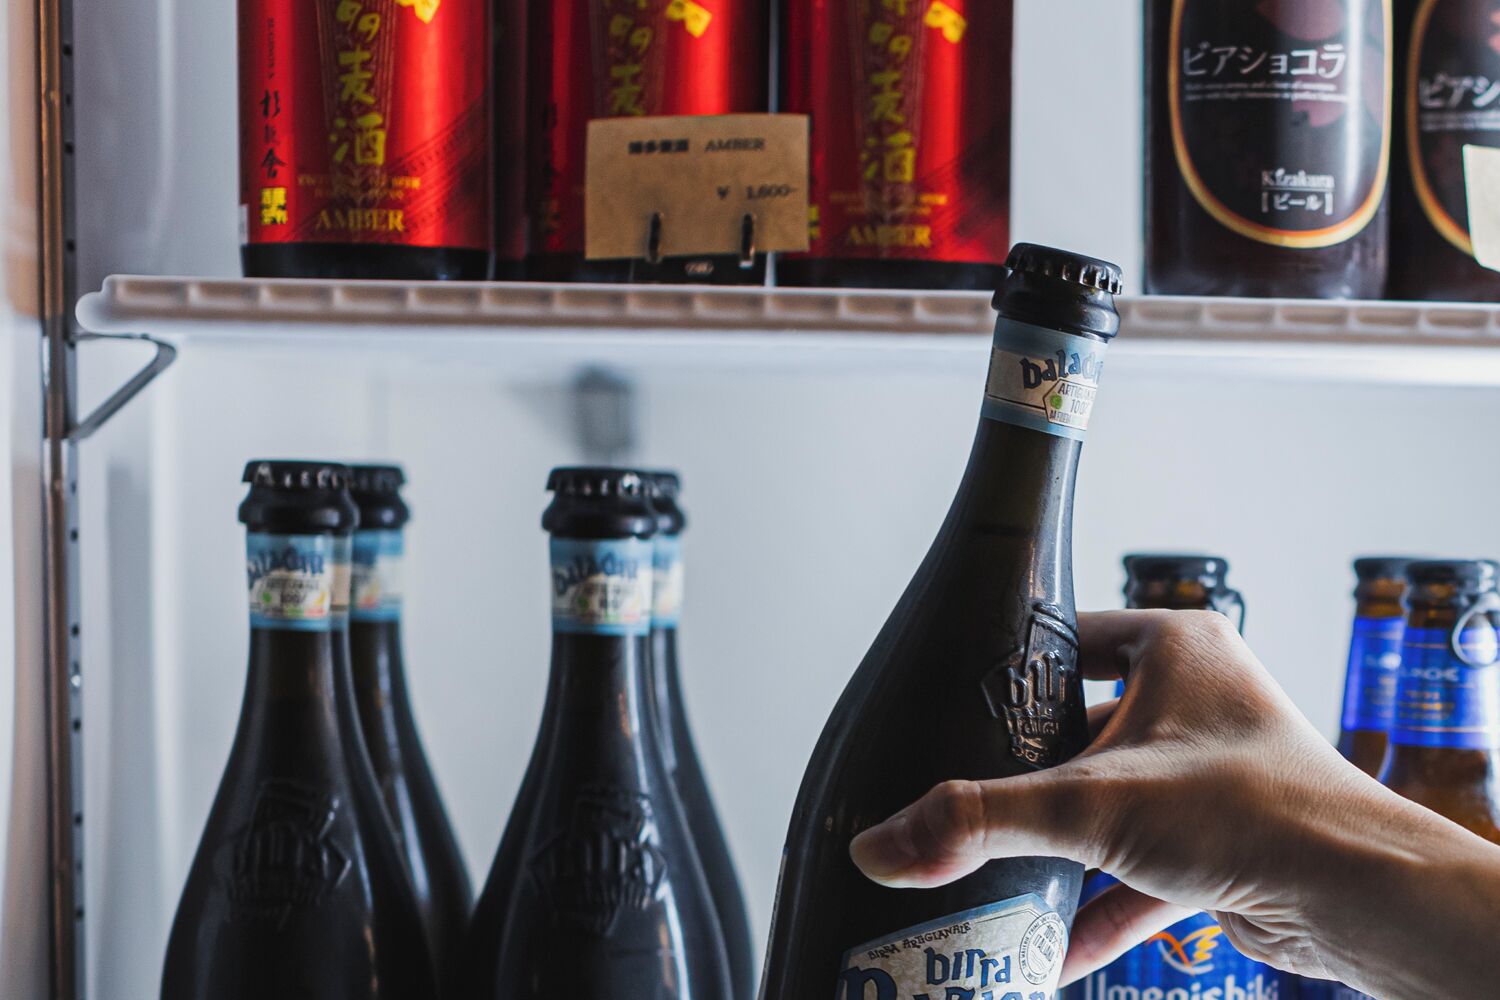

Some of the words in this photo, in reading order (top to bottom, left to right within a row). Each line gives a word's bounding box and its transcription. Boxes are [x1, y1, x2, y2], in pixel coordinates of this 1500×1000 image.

[1183, 41, 1347, 79] ビアショコラ
[316, 209, 405, 232] AMBER
[868, 943, 899, 961] BIRRA
[901, 921, 973, 952] ARTIGIANALE
[923, 946, 1013, 989] birra
